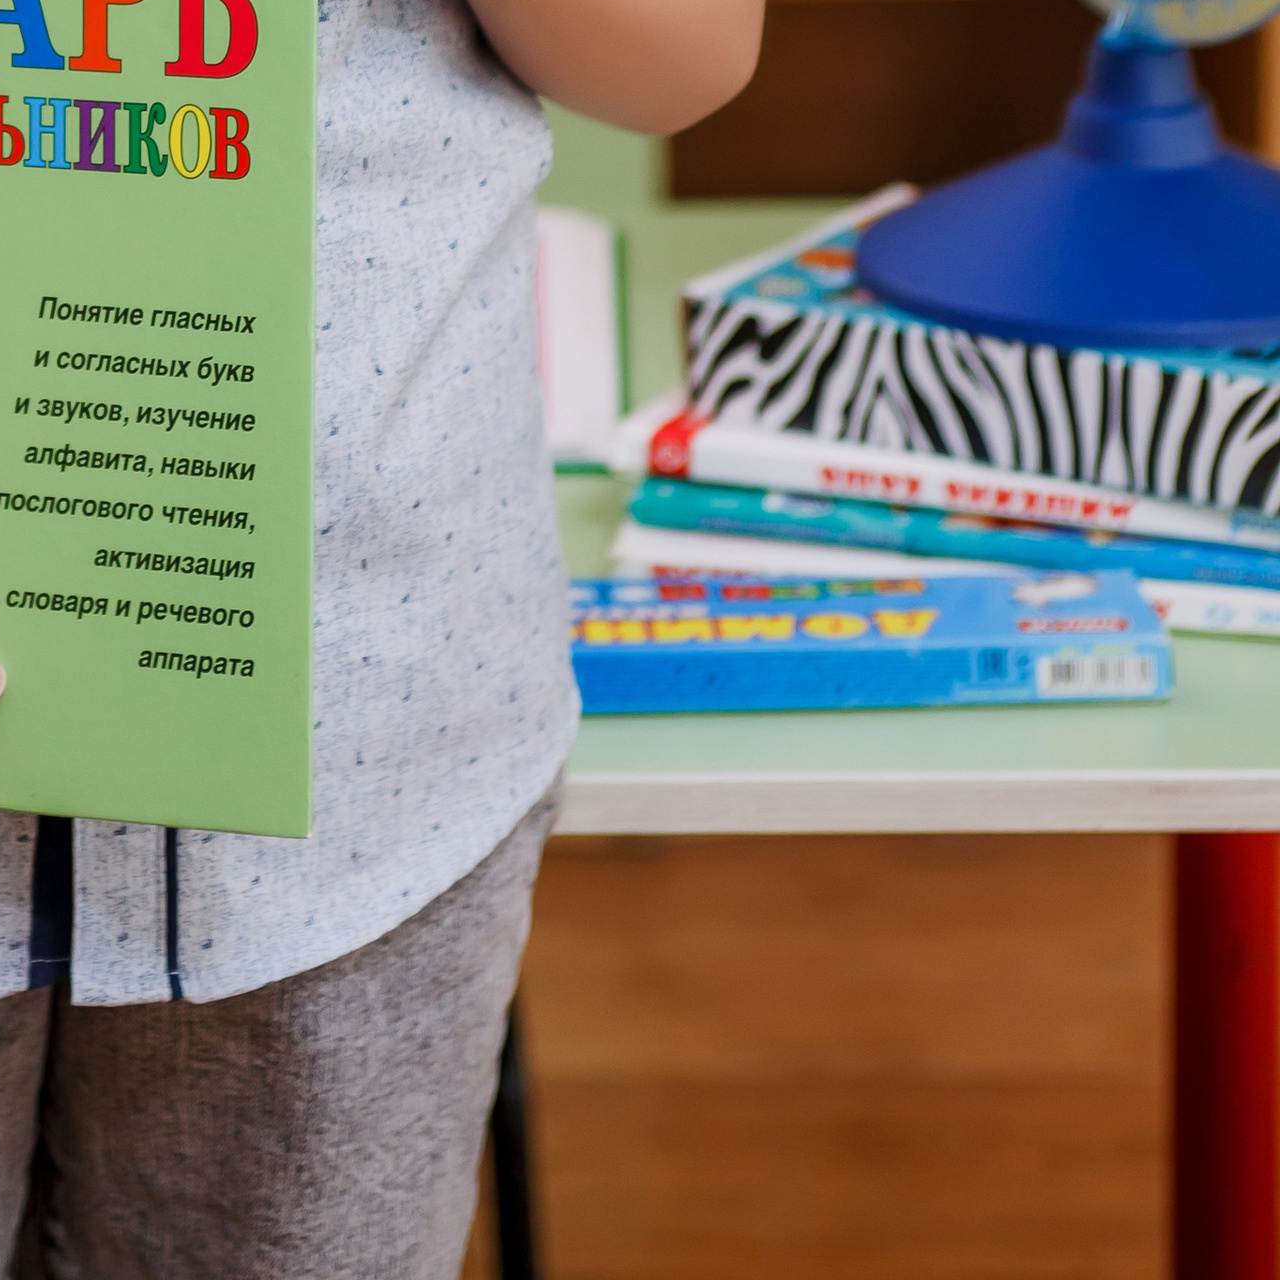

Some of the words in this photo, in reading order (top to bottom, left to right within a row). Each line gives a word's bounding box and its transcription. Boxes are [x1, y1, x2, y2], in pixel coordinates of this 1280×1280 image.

[38, 296, 144, 326] Понятие
[150, 309, 257, 334] гласных
[33, 350, 50, 368] и
[56, 351, 190, 378] согласных
[197, 355, 255, 387] букв
[14, 397, 30, 415] и
[36, 398, 130, 427] звуков,
[136, 405, 256, 433] изучение
[24, 444, 154, 476] алфавита,
[160, 458, 256, 481] навыки
[162, 505, 256, 535] чтения,
[94, 548, 256, 580] активизация
[6, 590, 109, 620] словаря
[115, 599, 132, 617] и
[136, 601, 255, 628] речевого
[568, 609, 940, 646] ДОМИН
[138, 650, 255, 679] аппарата
